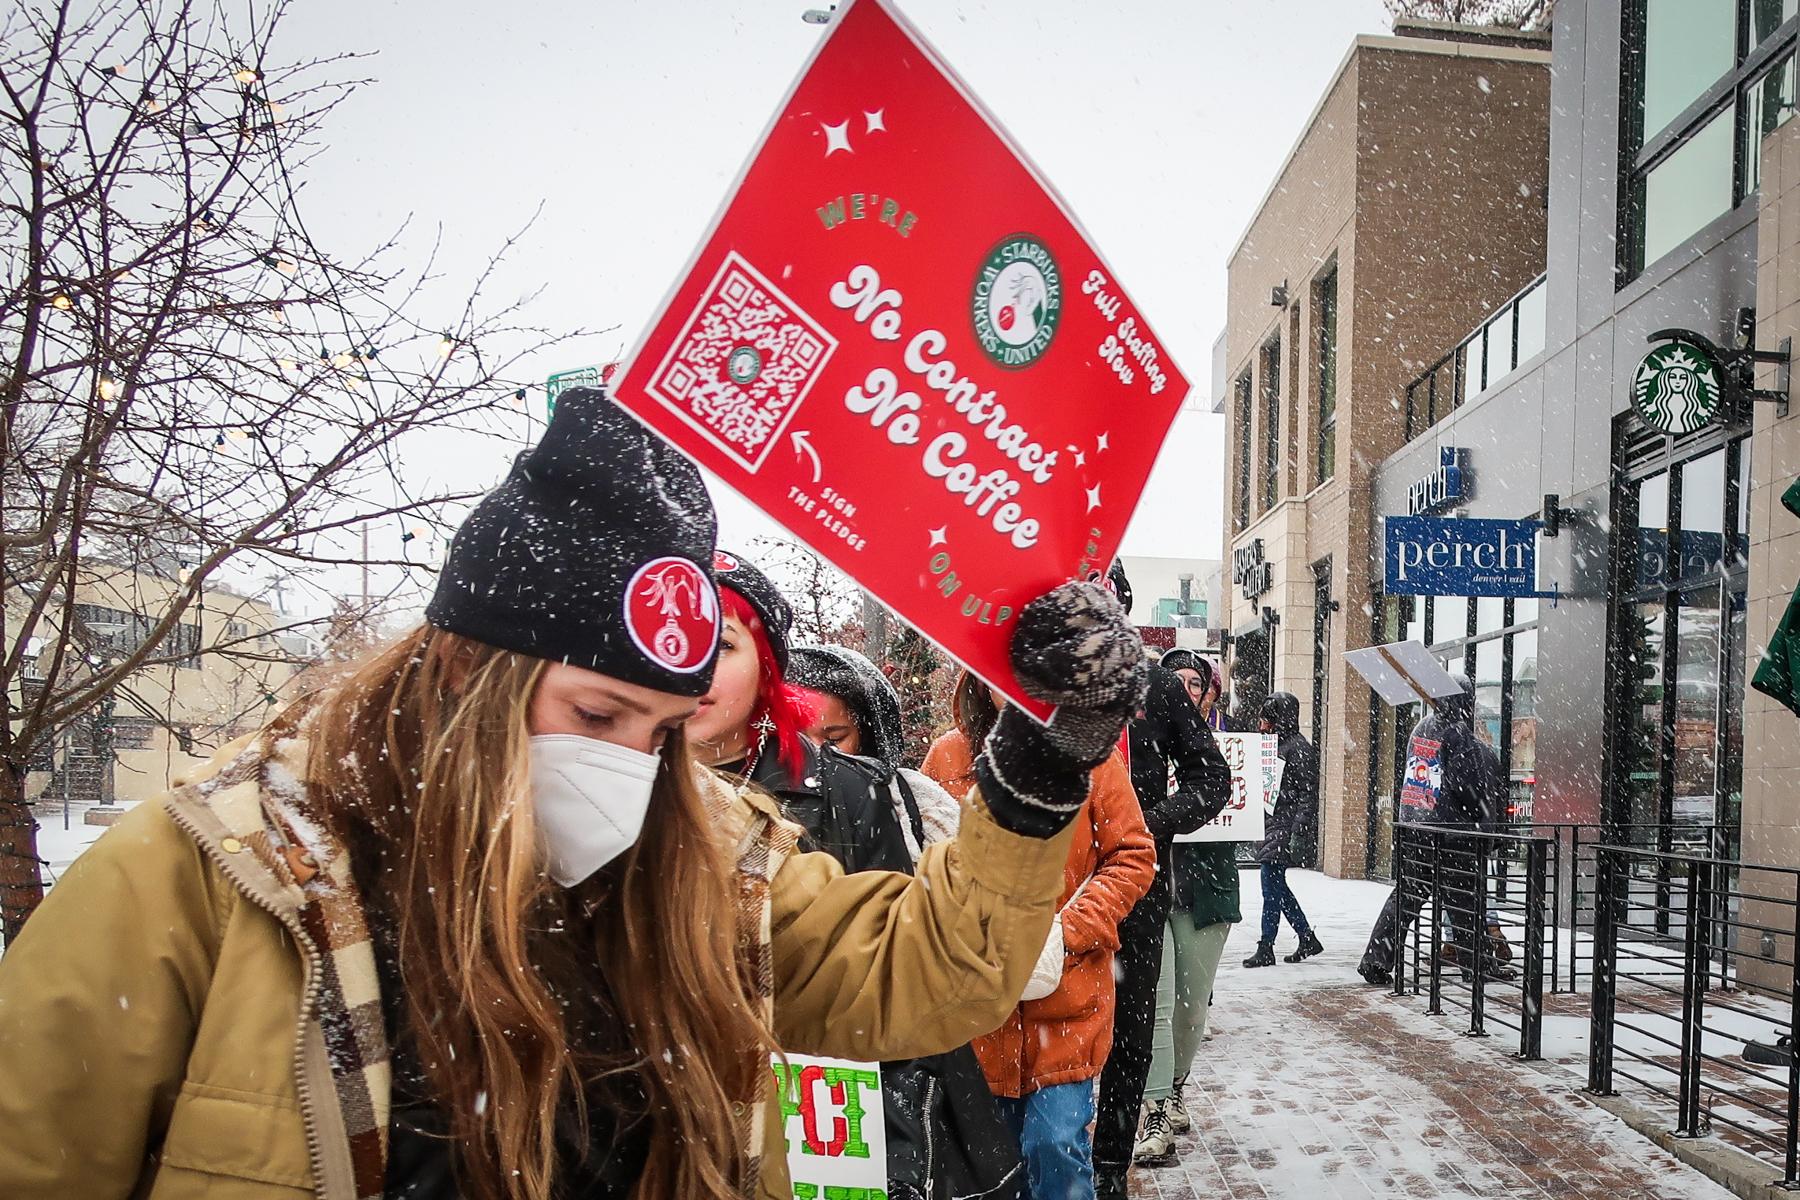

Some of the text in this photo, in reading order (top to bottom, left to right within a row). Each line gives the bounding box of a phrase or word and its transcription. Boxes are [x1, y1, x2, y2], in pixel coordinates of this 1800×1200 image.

[816, 193, 919, 238] WE'RE
[973, 266, 1001, 353] WORKERS
[1001, 242, 1060, 310] STARBUCKS
[1004, 324, 1053, 364] UNITED
[1081, 269, 1168, 395] Full Staffing
[1098, 334, 1134, 385] Now
[829, 264, 1059, 484] No Contract
[844, 367, 1040, 549] No Coffee
[1407, 446, 1449, 517] perch
[787, 486, 866, 551] THE PLEDGE
[820, 487, 857, 517] SIGN
[929, 552, 1013, 626] ON ULP
[1396, 529, 1526, 581] perch
[771, 1063, 879, 1158] ACT
